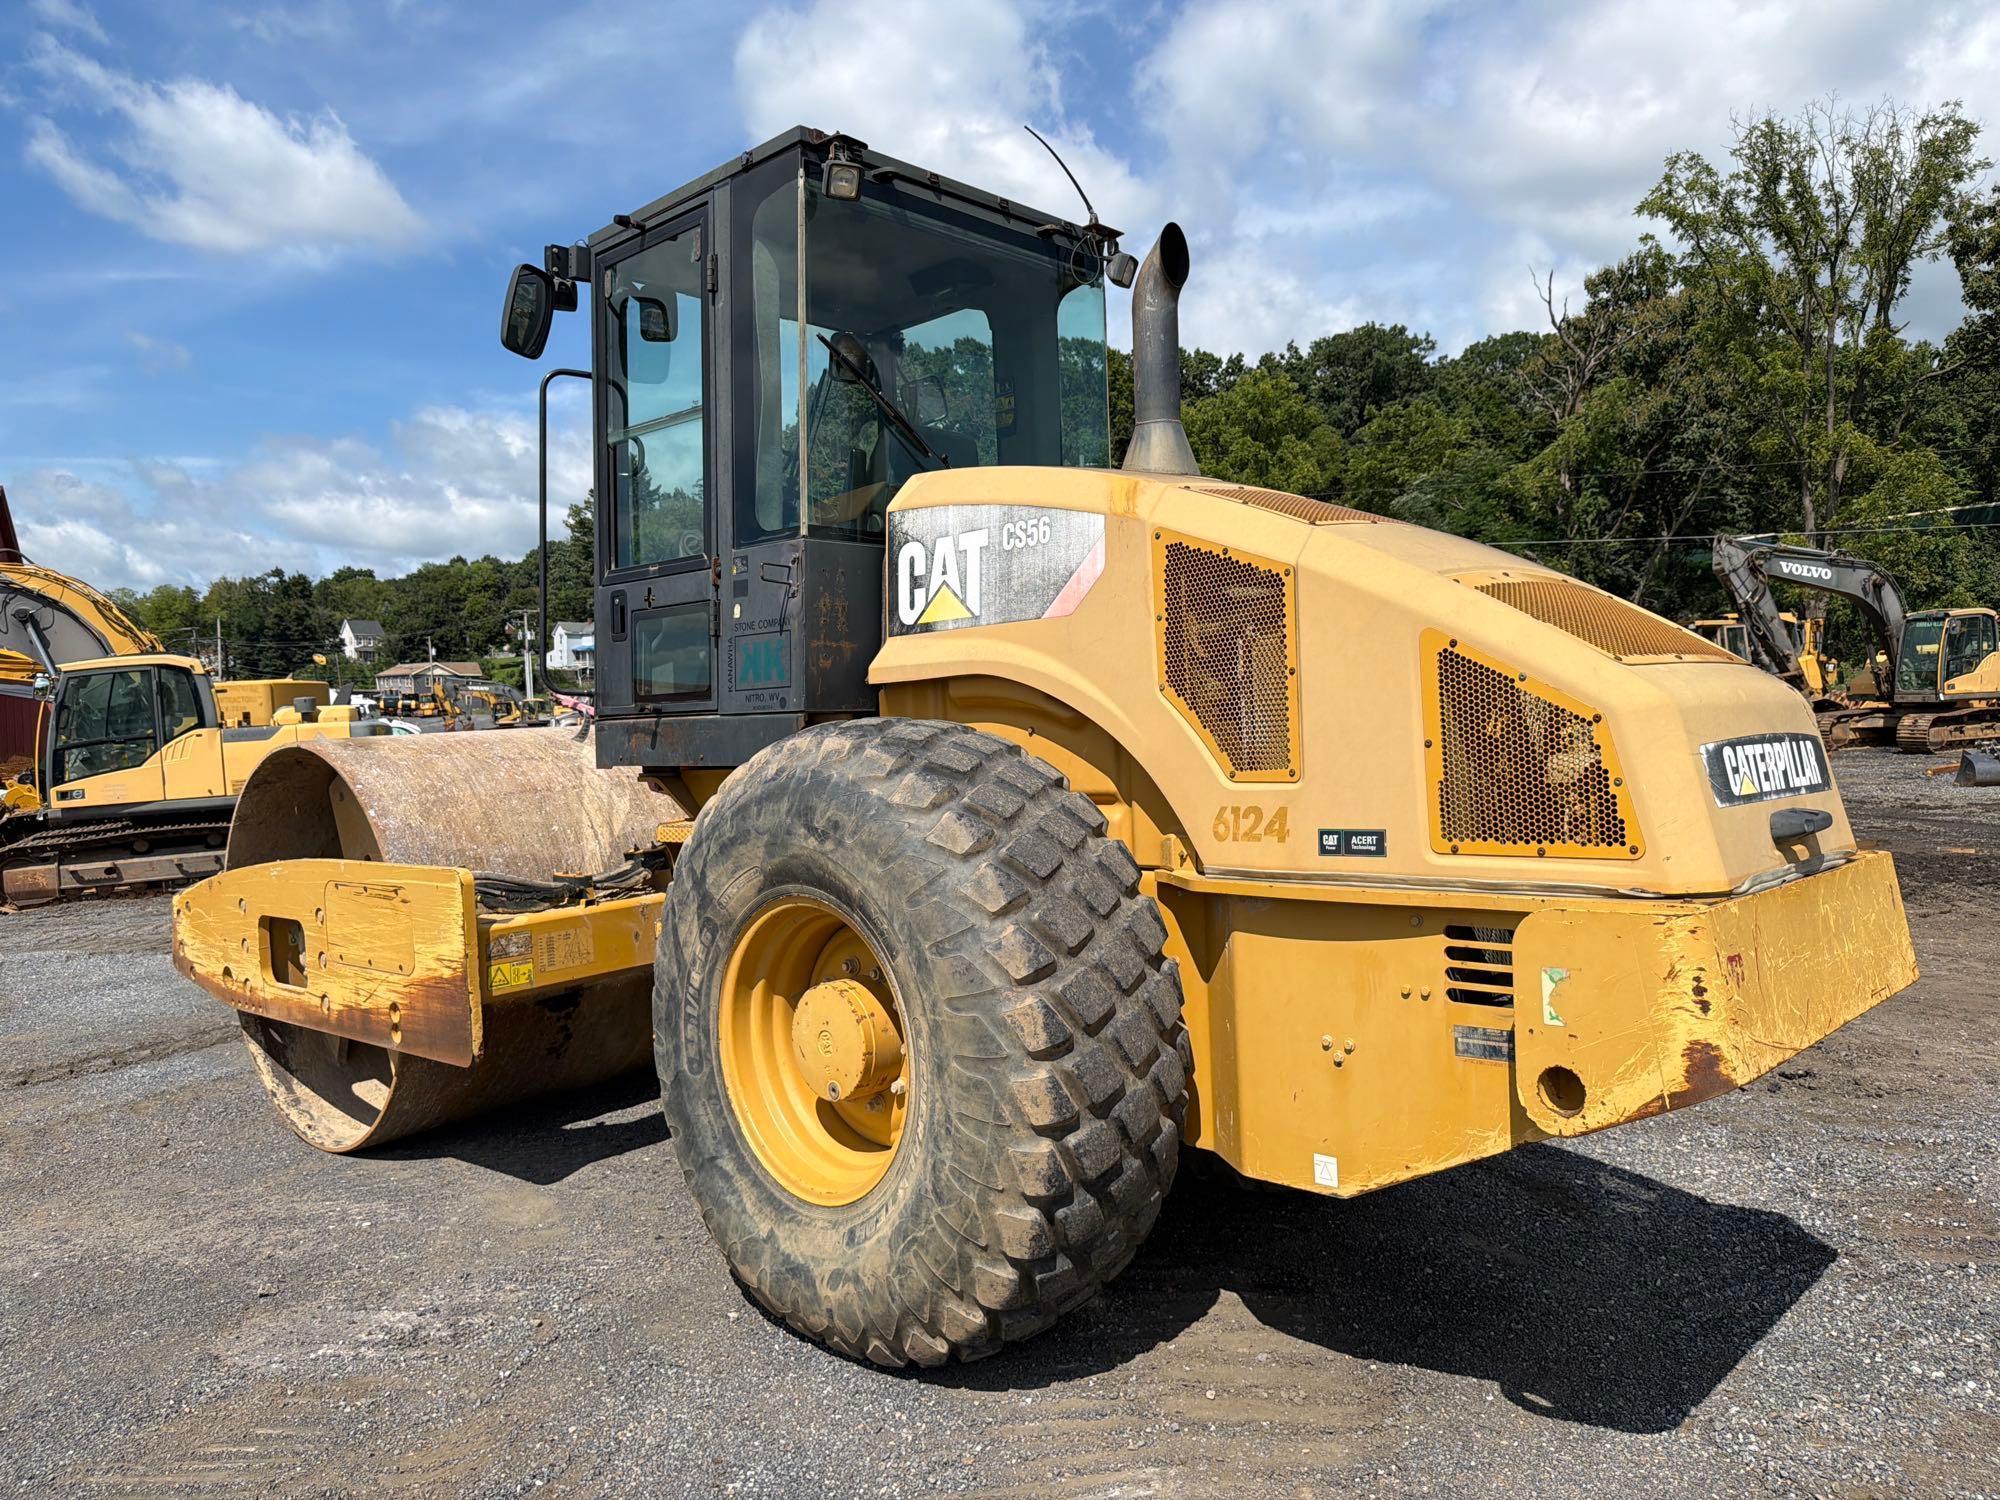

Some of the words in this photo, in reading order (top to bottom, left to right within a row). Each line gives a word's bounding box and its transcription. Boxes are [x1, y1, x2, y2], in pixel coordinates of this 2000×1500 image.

[1002, 516, 1051, 550] CS56
[898, 528, 989, 626] CAT
[1779, 561, 1832, 580] VOLVO
[735, 620, 756, 632] STONE
[768, 691, 780, 701] WV
[1722, 740, 1822, 796] CATERPILLAR
[1212, 806, 1290, 843] 6124
[1322, 834, 1339, 846] CAT
[1351, 835, 1377, 845] ACERT
